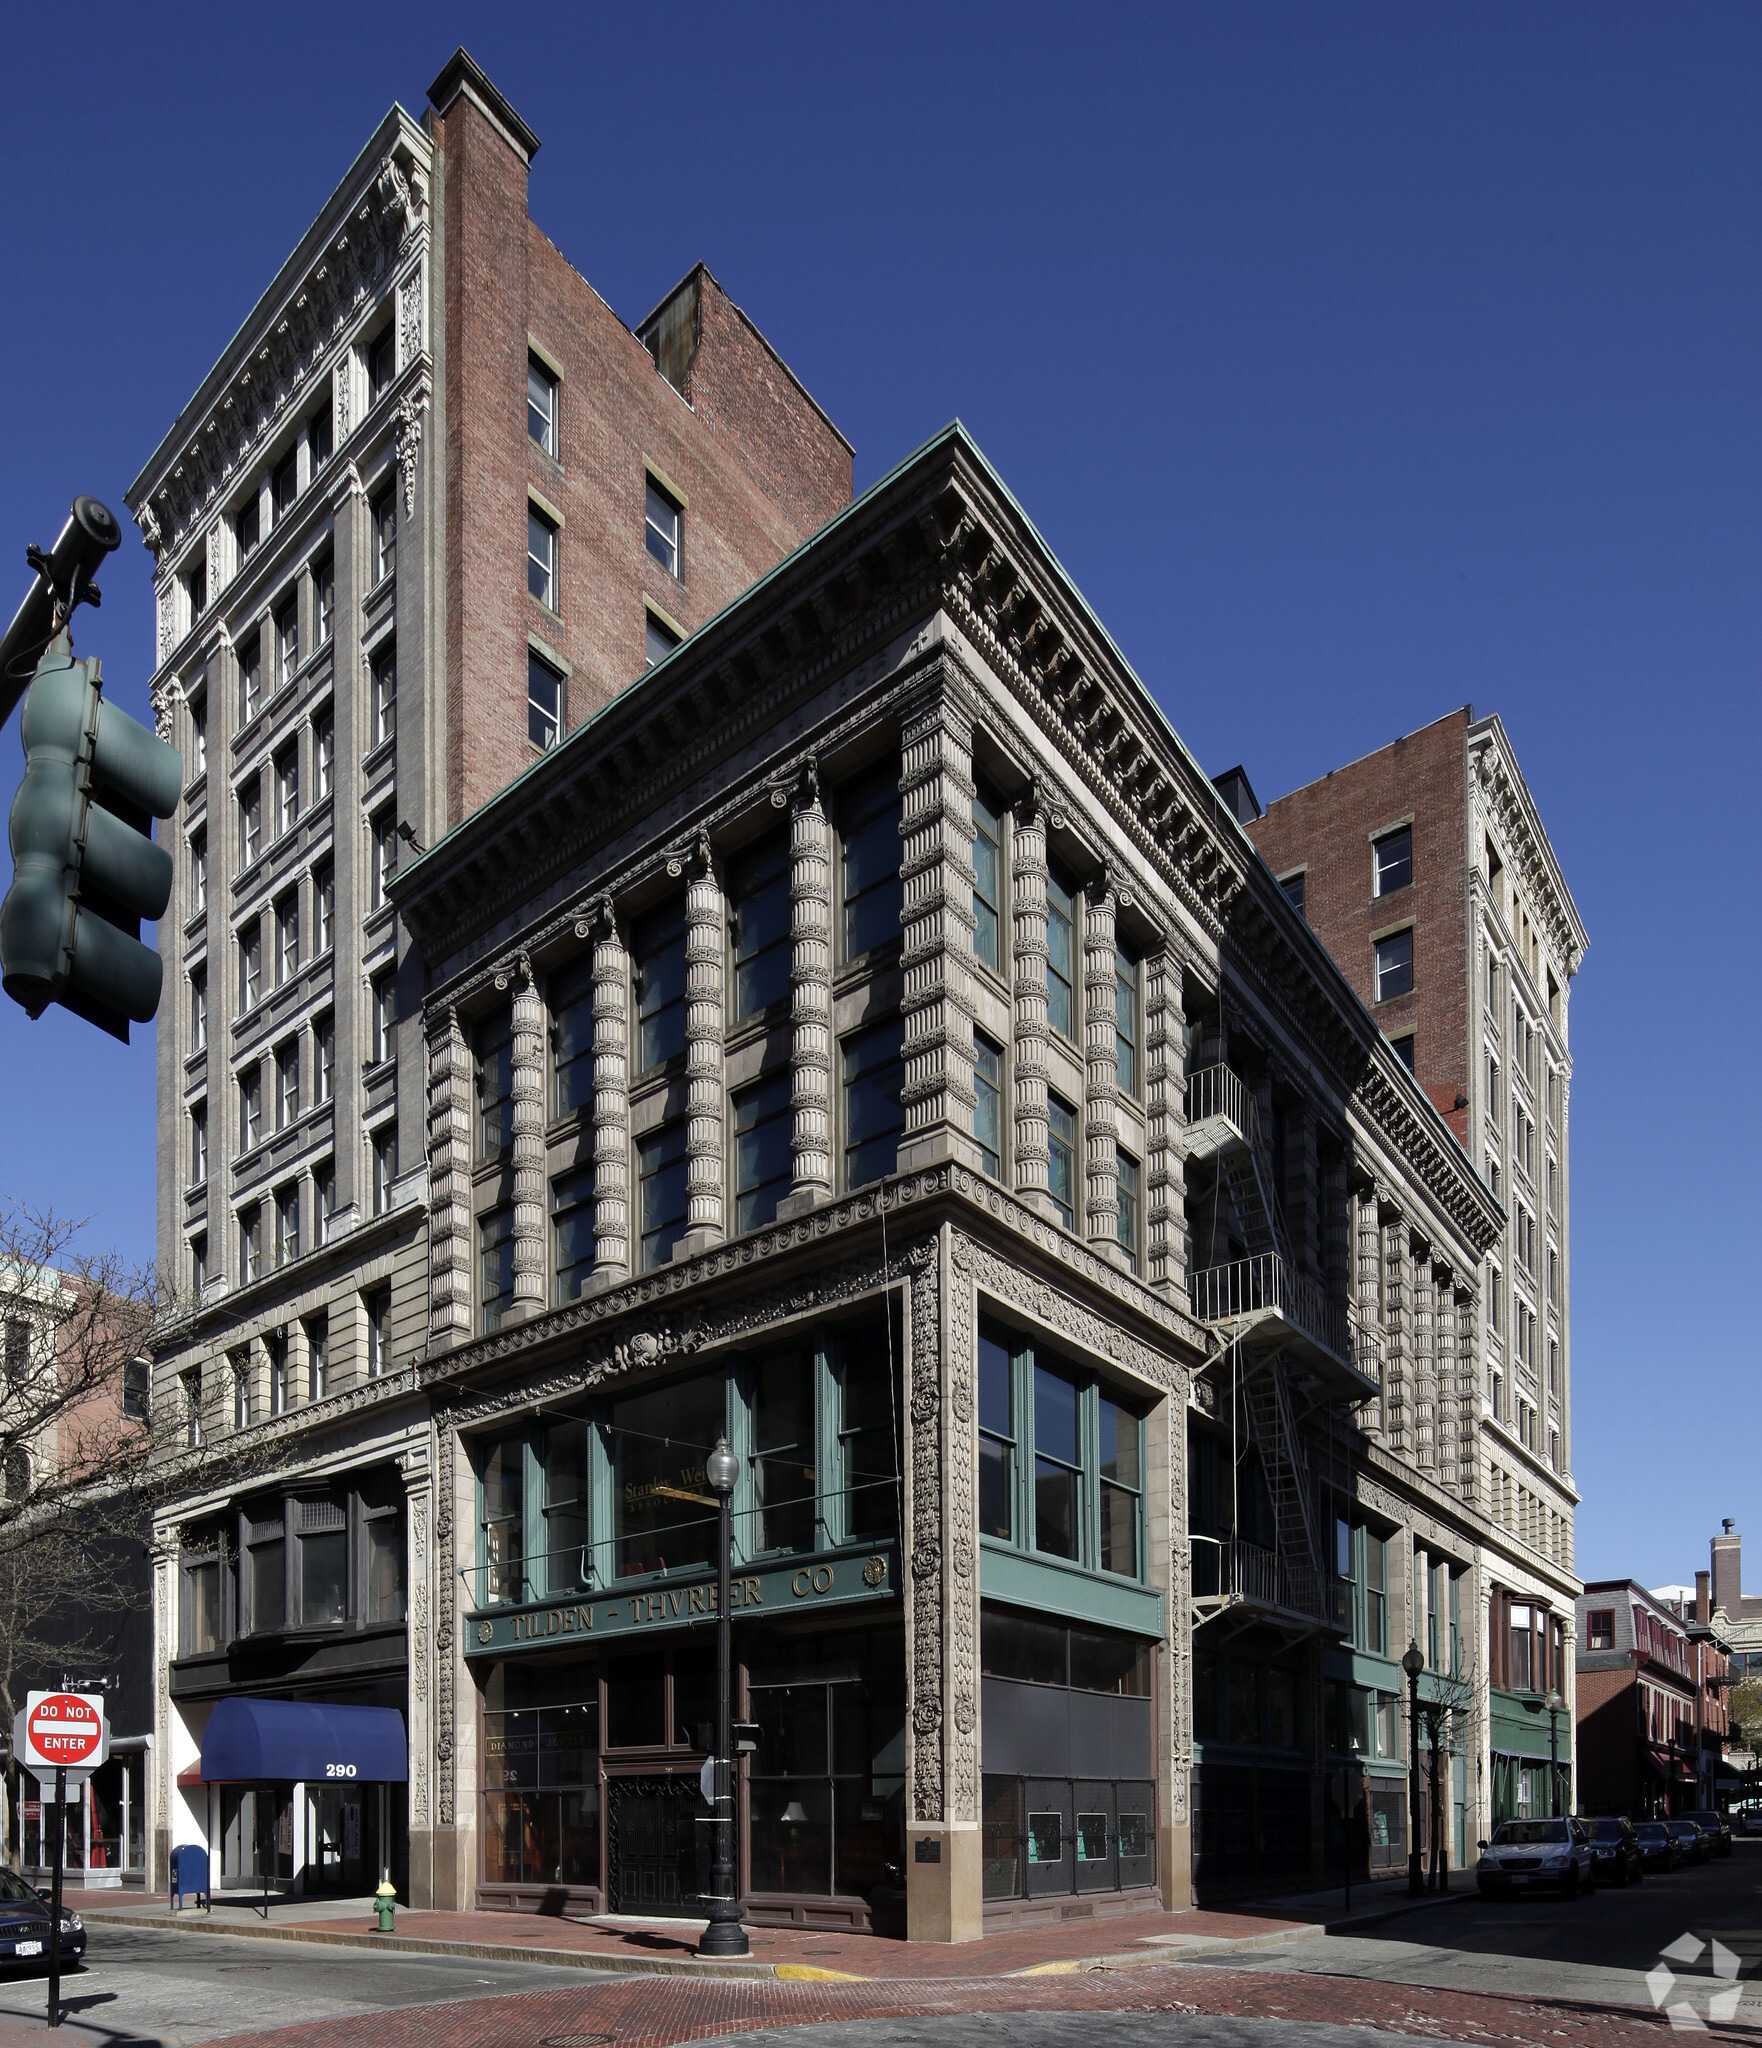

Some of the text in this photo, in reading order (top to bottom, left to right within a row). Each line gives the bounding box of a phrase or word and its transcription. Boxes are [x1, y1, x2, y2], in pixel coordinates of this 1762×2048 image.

[510, 1604, 594, 1640] TILDEN
[792, 1564, 834, 1597] CO
[40, 1705, 91, 1718] DO NOT
[44, 1737, 86, 1749] ENTER
[326, 1763, 357, 1777] 290
